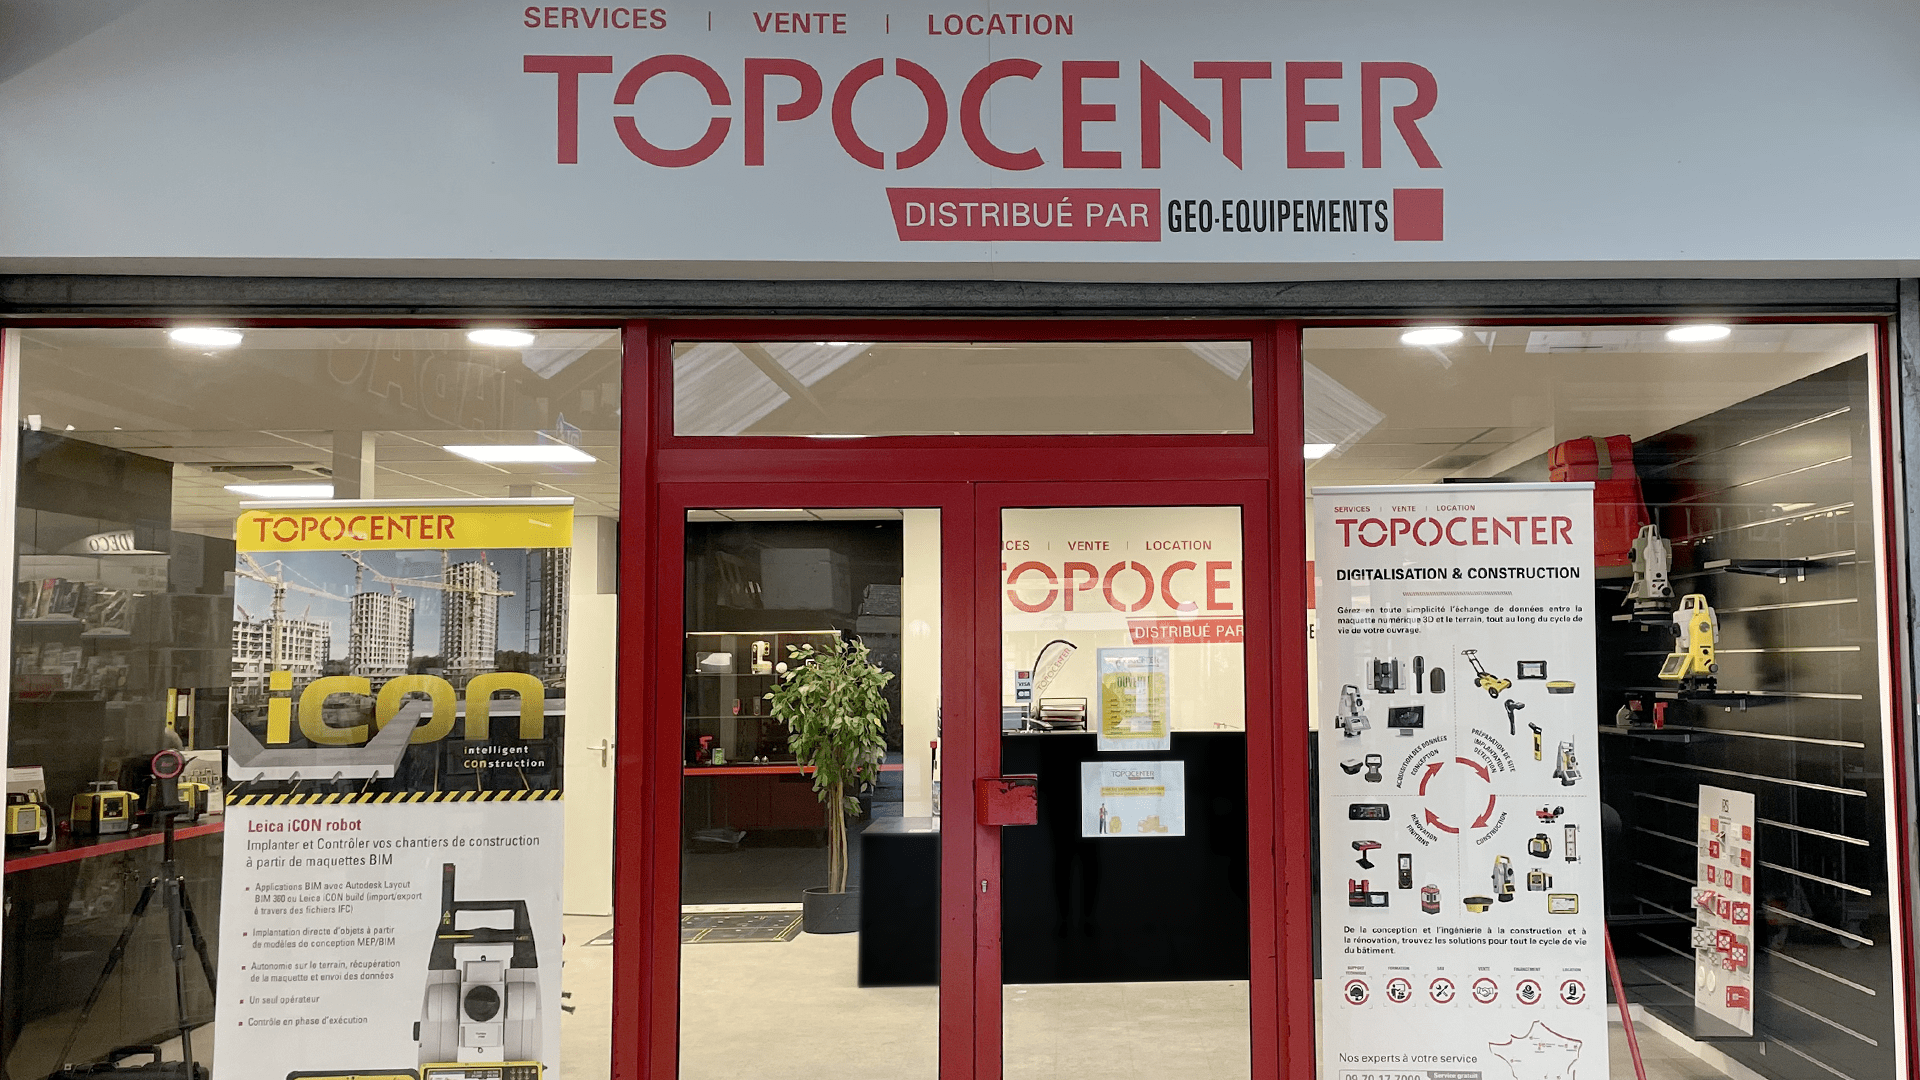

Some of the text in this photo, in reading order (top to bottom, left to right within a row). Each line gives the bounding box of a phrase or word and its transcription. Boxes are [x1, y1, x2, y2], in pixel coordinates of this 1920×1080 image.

[523, 6, 1074, 35] SERVICES VENTE LOCATION
[523, 54, 1443, 171] TOPOCENTER
[905, 197, 1389, 234] DISTRIBUÉ PAR GEO-EQUIPEMENTS
[253, 515, 455, 542] TOPOCENTER
[1336, 516, 1573, 547] TOPOCENTER
[1068, 541, 1109, 550] VENTE
[1146, 541, 1212, 550] LOCATION
[1336, 567, 1580, 580] DIGITALISATION & CONSTRUCTION
[1002, 560, 1233, 613] OPOCE
[1337, 606, 1360, 614] Gérez
[1406, 606, 1445, 614] simplicité
[1450, 606, 1489, 614] l'échange
[1338, 617, 1375, 625] maquette
[1378, 616, 1421, 624] numérique
[1455, 616, 1484, 624] terrain,
[1517, 616, 1535, 624] long
[1550, 616, 1571, 624] cycle
[1135, 625, 1210, 638] DISTRIBUÉ
[464, 745, 529, 756] intelligent
[1412, 746, 1422, 756] DES
[1422, 735, 1448, 748] DONNÉES
[1474, 738, 1505, 772] IMPLANTATION
[1474, 746, 1497, 774] DÉTECTION
[1504, 751, 1510, 761] DE
[1507, 760, 1516, 772] SITE
[1410, 748, 1439, 776] CONCEPTION
[248, 819, 362, 832] Leica iCON robot
[1410, 814, 1438, 842] RÉNOVATION
[1476, 812, 1508, 846] CONSTRUCTION
[1406, 824, 1430, 846] FINITIONS
[247, 835, 540, 853] Implanter et Contrôler vos chantiers de construction
[246, 854, 393, 869] à partir de maquettes BIM
[255, 883, 302, 892] Applications
[305, 882, 321, 890] BIM
[346, 881, 382, 889] Autodesk
[384, 881, 410, 890] Layout
[323, 893, 343, 901] iCON
[346, 893, 364, 901] build
[290, 906, 303, 914] des
[306, 905, 335, 913] fichiers
[338, 905, 353, 913] IFC)
[253, 928, 300, 937] Implantation
[333, 927, 364, 936] d'objets
[374, 926, 394, 935] partir
[1372, 927, 1417, 935] conception
[1437, 927, 1482, 935] l'ingénierie
[253, 940, 261, 948] de
[264, 940, 296, 948] modèles
[311, 939, 355, 948] conception
[357, 937, 395, 946] MEP/BIM
[1354, 937, 1399, 945] rénovation,
[1488, 938, 1508, 946] pour
[1539, 937, 1560, 946] cycle
[251, 962, 292, 970] Autonomie
[319, 961, 347, 969] terrain,
[351, 960, 400, 969] récupération
[251, 974, 259, 982] de
[271, 974, 308, 983] maquette
[311, 973, 318, 981] et
[344, 972, 358, 980] des
[360, 972, 394, 980] données
[262, 995, 278, 1003] seul
[280, 996, 320, 1004] opérateur
[248, 1017, 280, 1026] Contrôle
[295, 1017, 319, 1026] phase
[322, 1016, 367, 1024] d'exécution
[1340, 1053, 1359, 1062] Nos
[1362, 1054, 1400, 1064] experts
[1402, 1054, 1408, 1062] à
[1440, 1055, 1478, 1063] service
